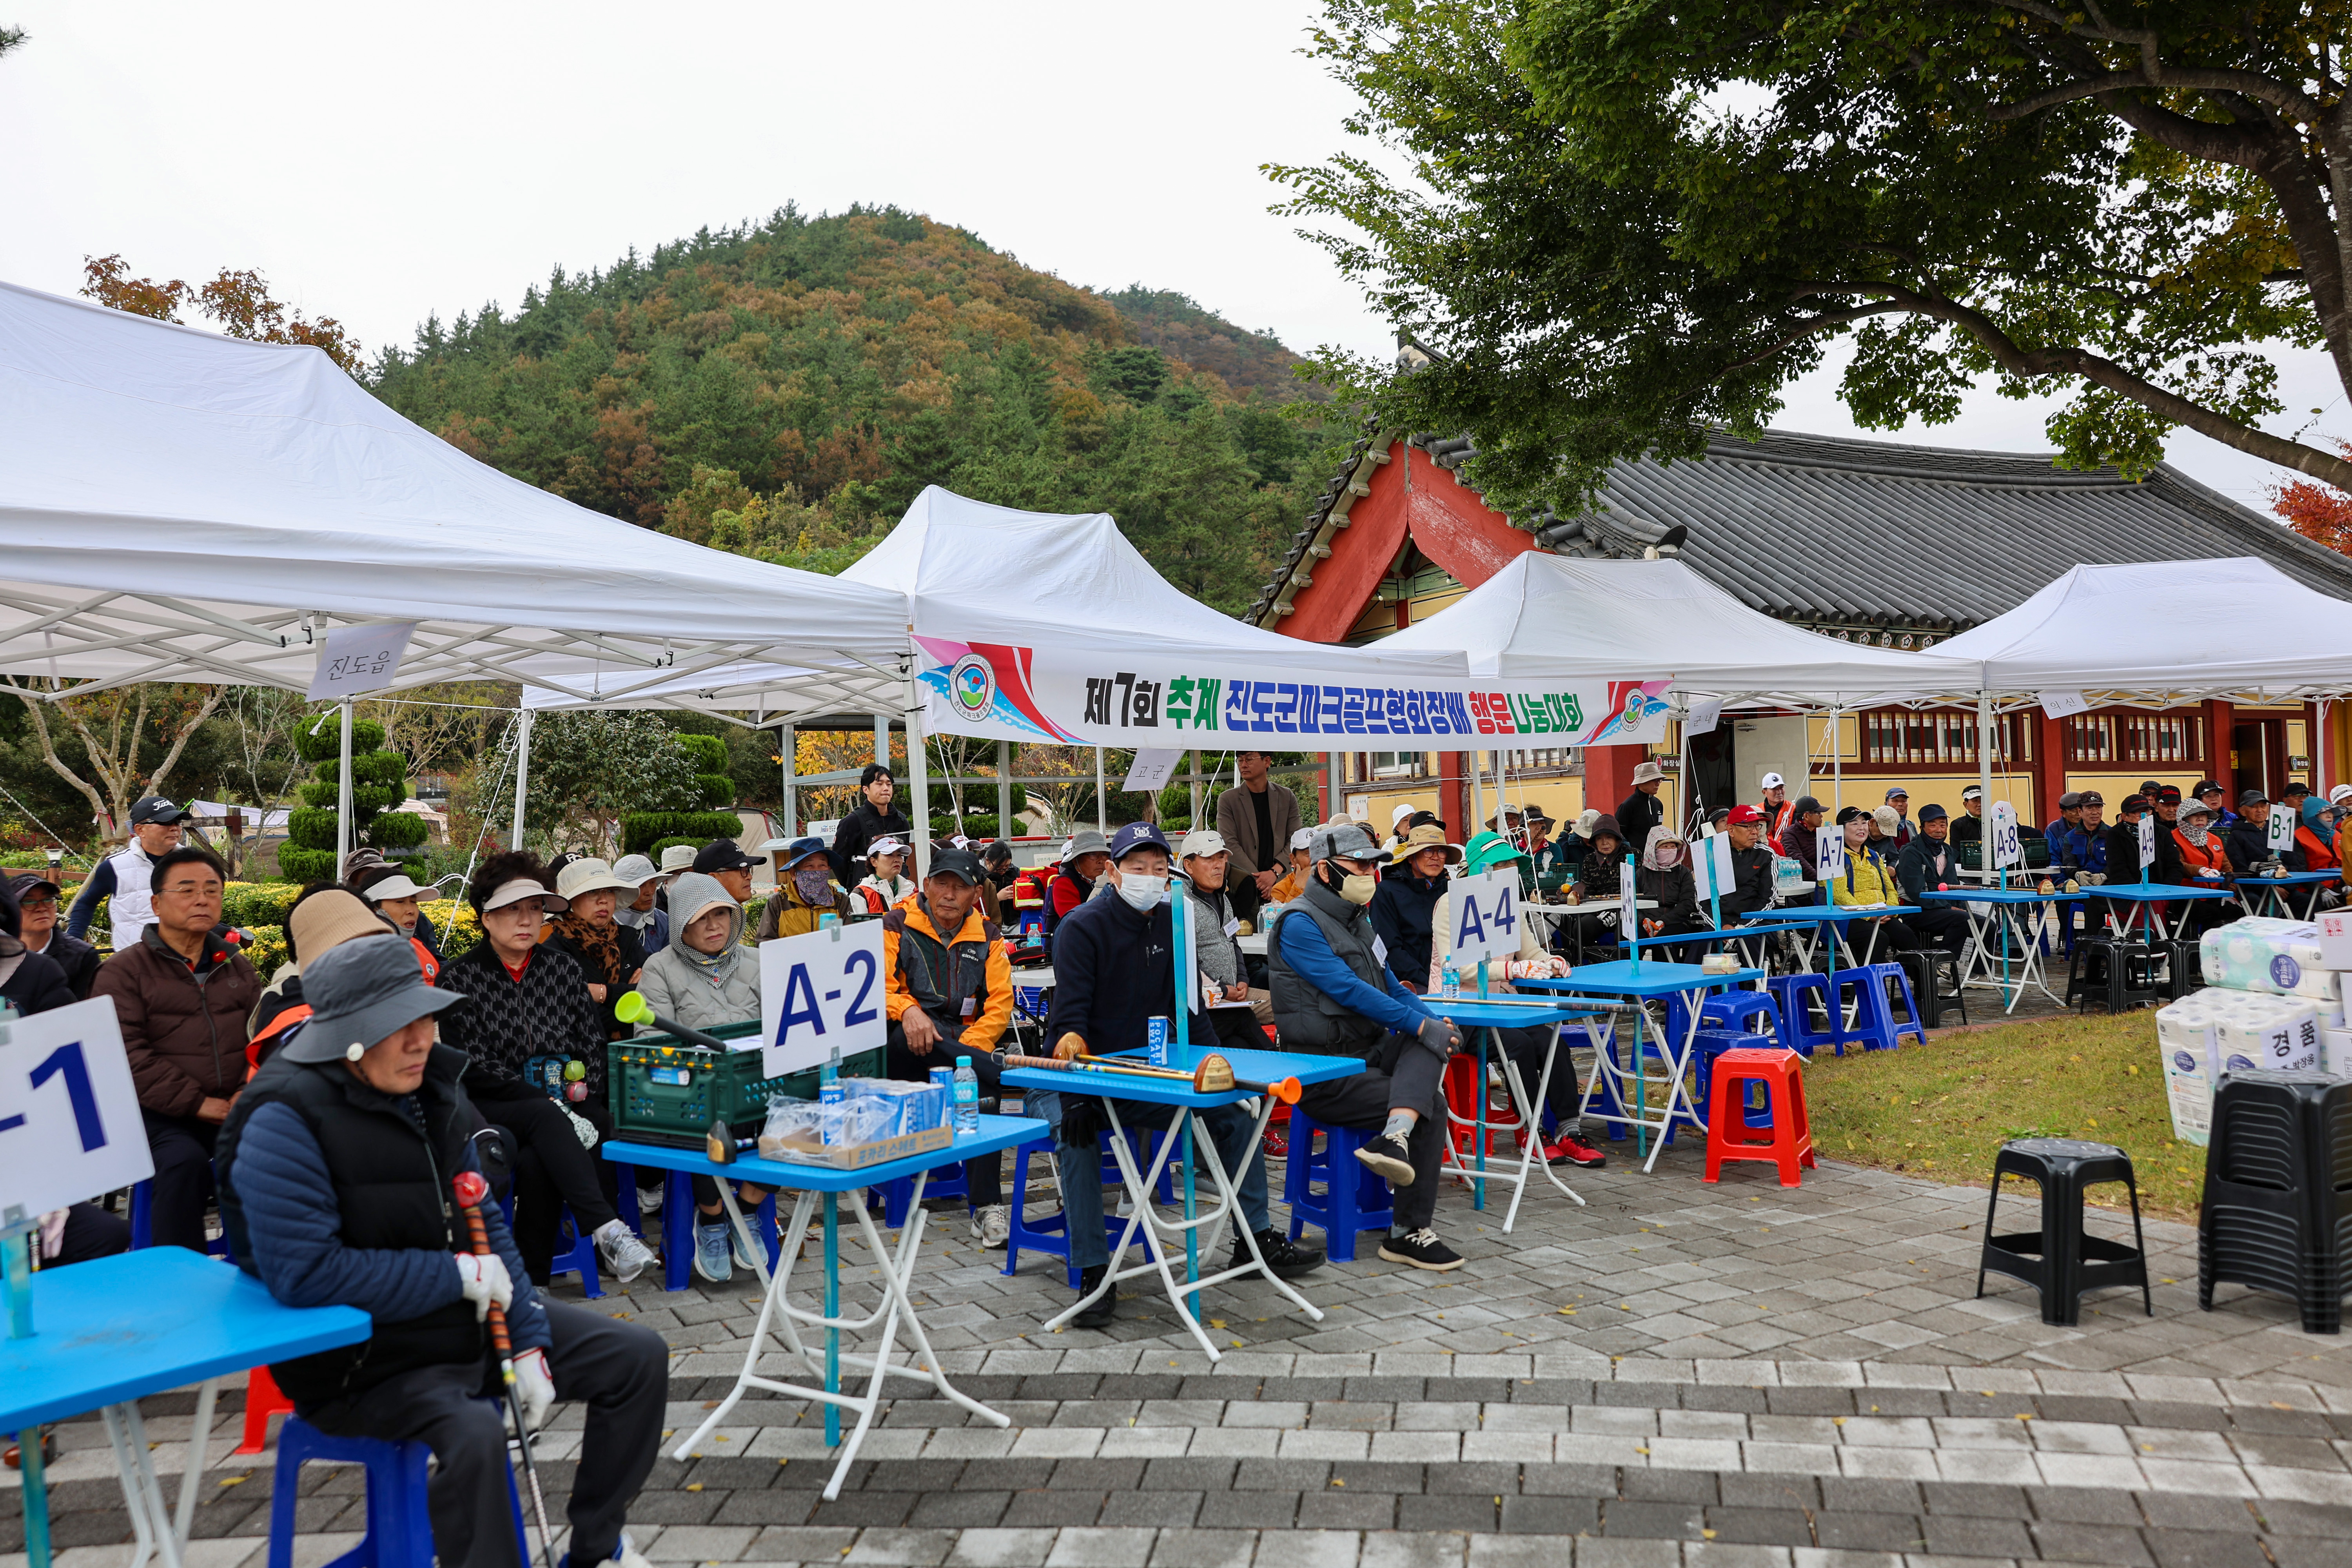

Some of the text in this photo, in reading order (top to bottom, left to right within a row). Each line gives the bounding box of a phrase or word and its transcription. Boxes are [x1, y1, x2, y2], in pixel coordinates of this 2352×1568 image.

[328, 651, 390, 680] 진도읍
[951, 662, 963, 685] JINDOGUN
[981, 660, 994, 688] ASSOCIATION
[954, 700, 990, 718] 진도군파크골프협회
[1084, 672, 1161, 728] 제7회
[1166, 675, 1221, 731] 추계
[1225, 679, 1473, 735] 진도군파크골프협회장배
[1997, 825, 2016, 858] A-8
[2141, 825, 2154, 858] A-9
[2271, 813, 2292, 842] B-1
[1820, 836, 1842, 869] A-7
[1457, 886, 1516, 949] A-4
[1622, 877, 1633, 925] A-5
[775, 949, 877, 1047] A-2
[857, 1145, 887, 1164] 포카리
[889, 1138, 917, 1156] 스웨트
